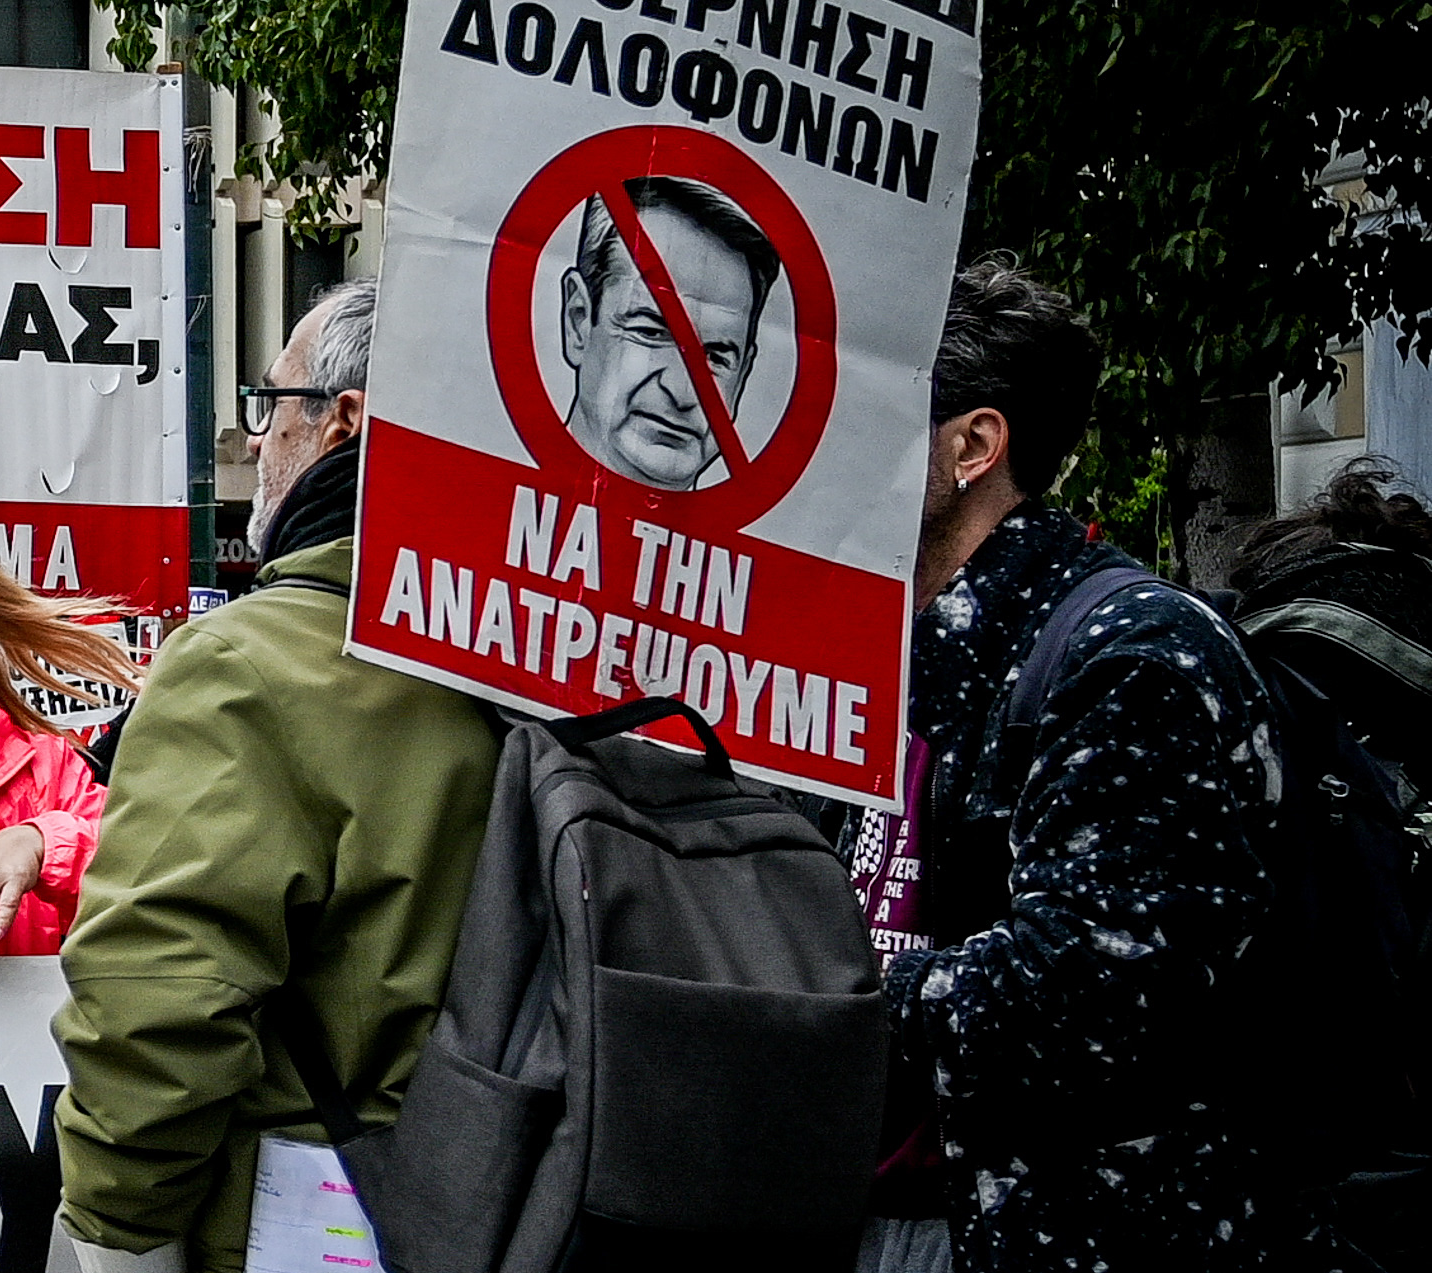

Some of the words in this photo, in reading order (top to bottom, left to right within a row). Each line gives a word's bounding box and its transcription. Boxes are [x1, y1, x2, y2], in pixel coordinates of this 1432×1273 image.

[505, 485, 601, 592] ΝΑ
[631, 522, 753, 636] ΤΗΝ
[380, 547, 868, 765] ΑΝΑΤΡΕΨΟΥΜΕ
